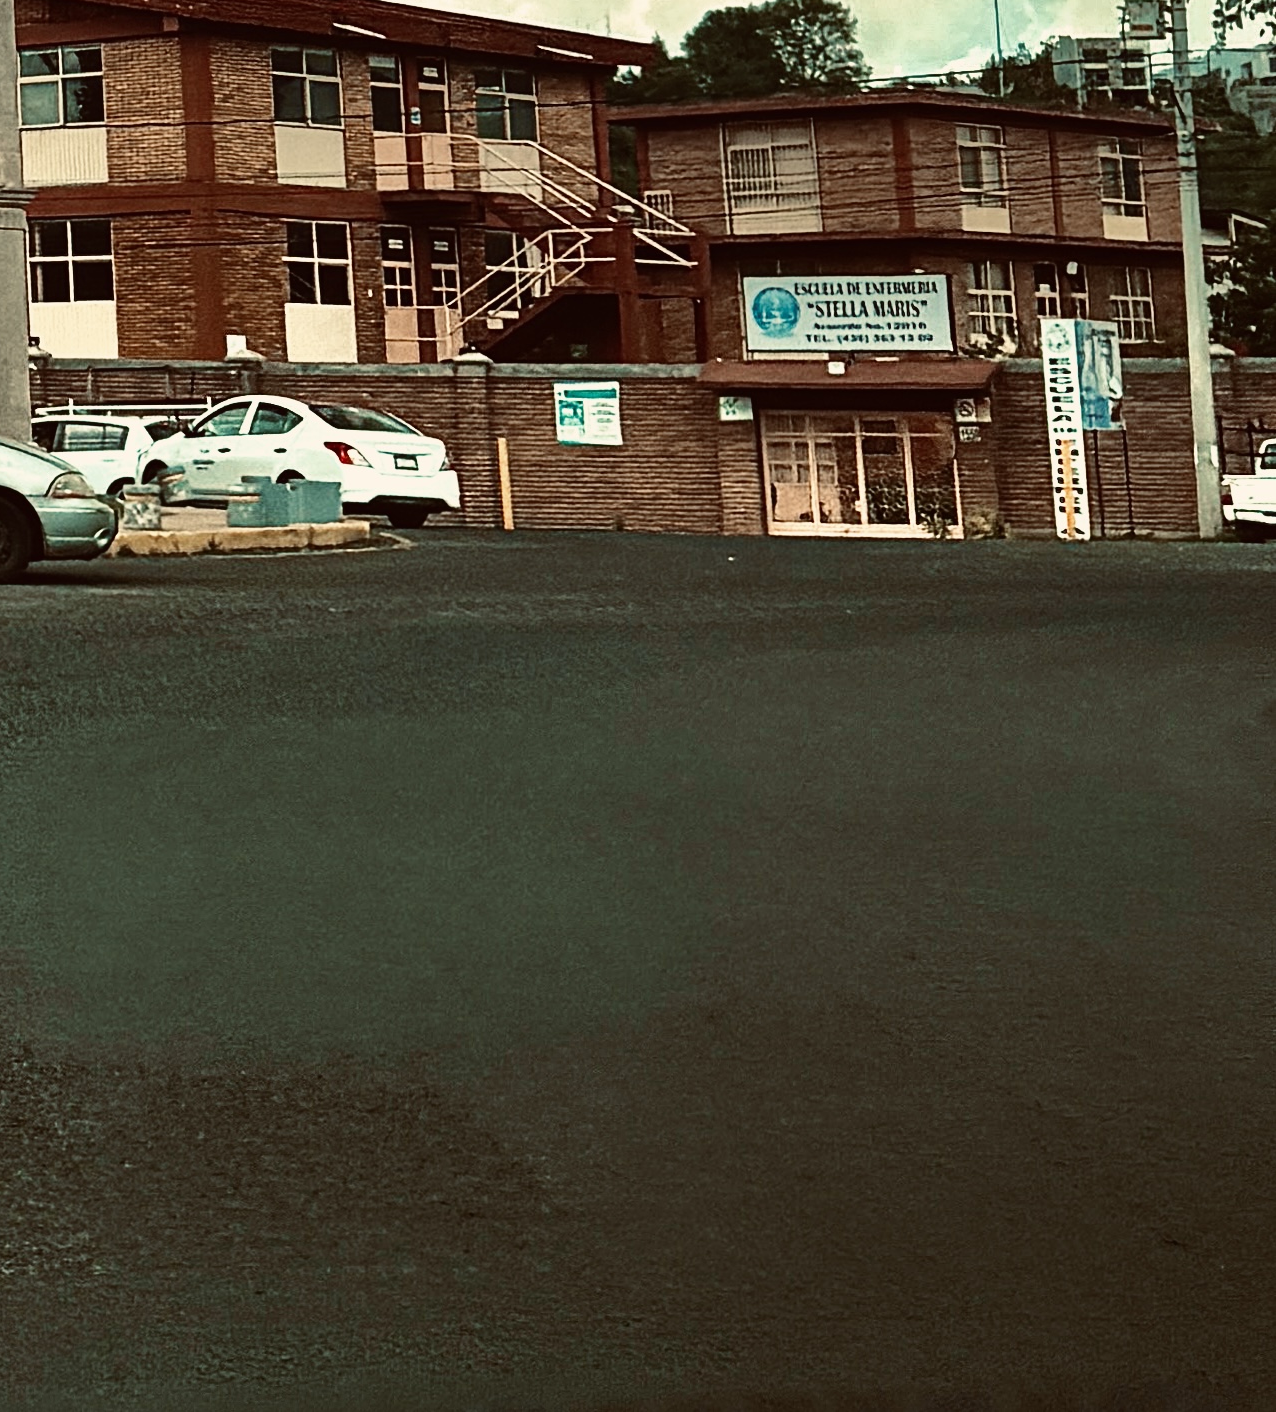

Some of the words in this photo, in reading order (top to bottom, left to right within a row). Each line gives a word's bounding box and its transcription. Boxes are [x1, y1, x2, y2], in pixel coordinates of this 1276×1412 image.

[794, 282, 844, 296] ESCUELA
[847, 282, 862, 295] DE
[865, 281, 938, 295] ENFERMERIA
[807, 300, 868, 318] "STELLA
[872, 299, 928, 318] MARIS"
